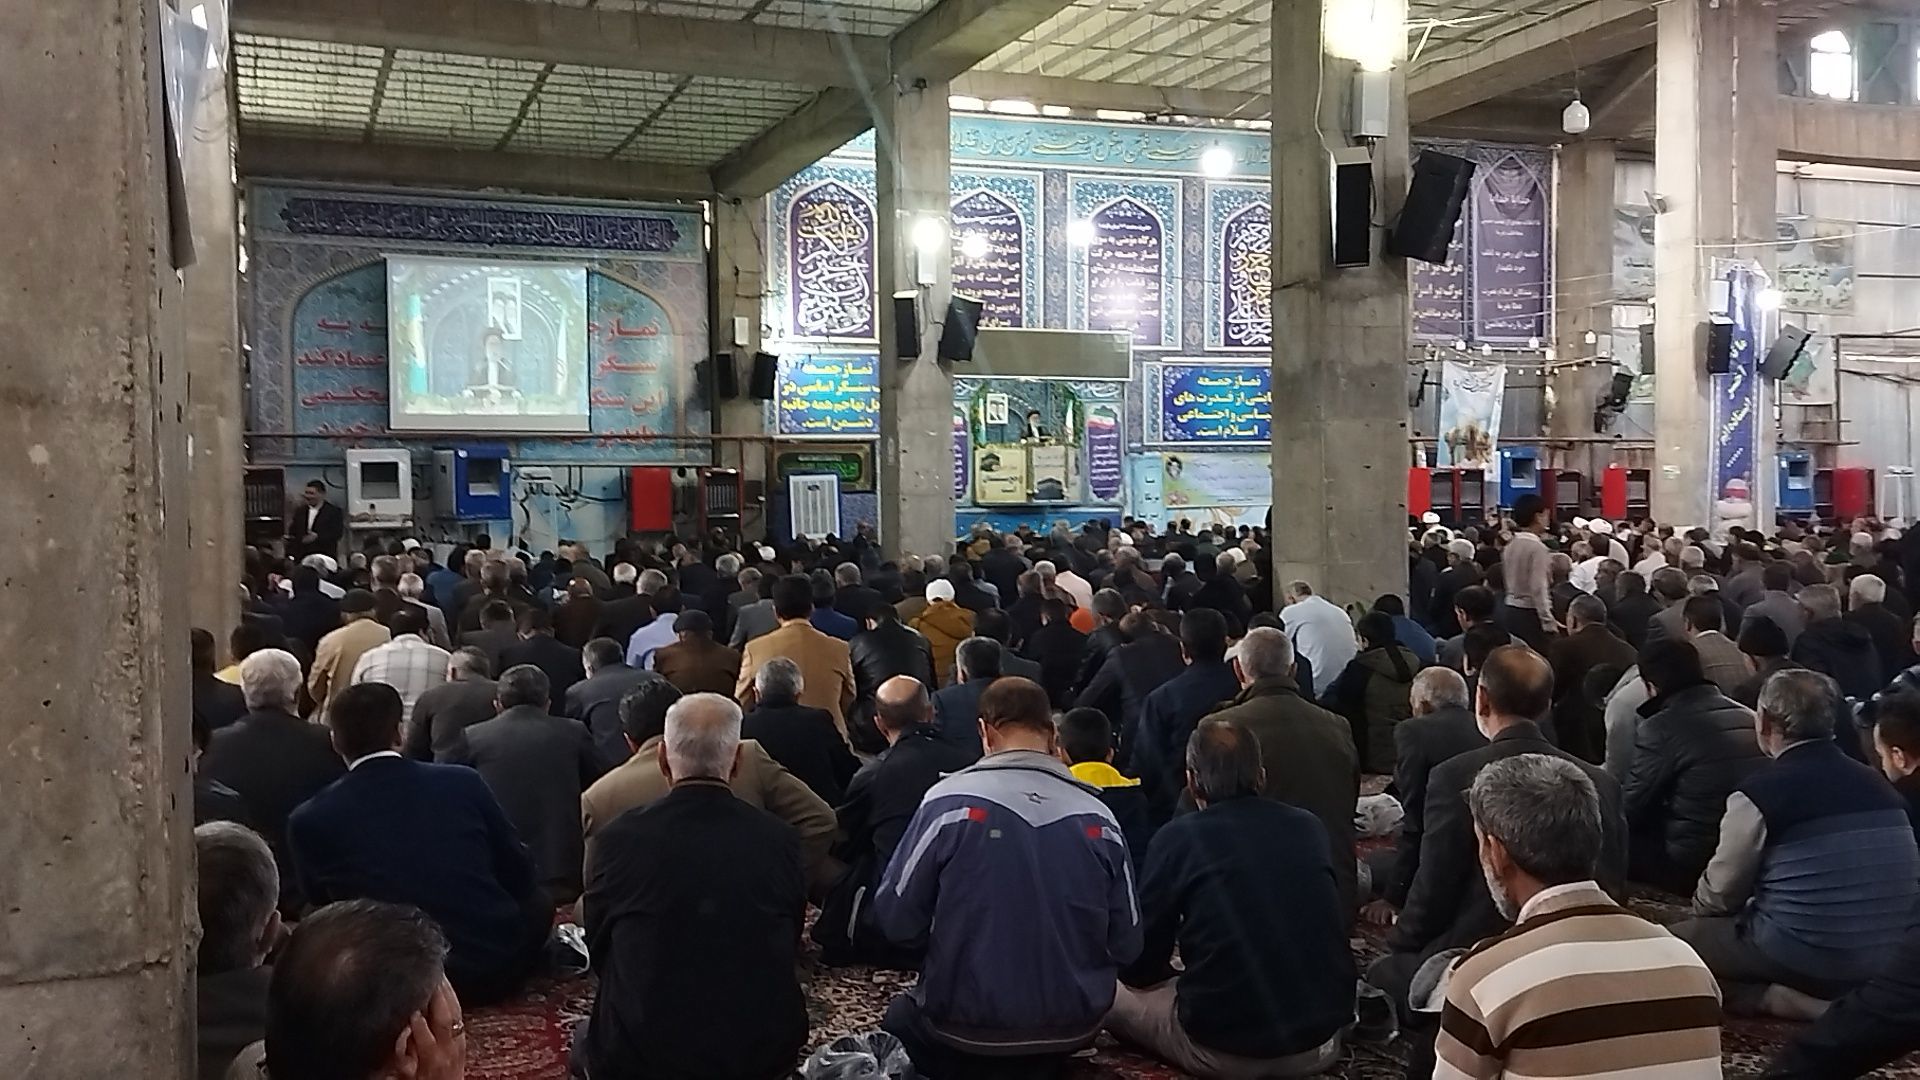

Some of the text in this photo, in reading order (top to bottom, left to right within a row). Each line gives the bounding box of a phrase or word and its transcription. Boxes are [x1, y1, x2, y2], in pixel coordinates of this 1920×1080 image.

[606, 317, 660, 342] نماز
[597, 355, 658, 378] سنگر
[801, 361, 873, 378] نماز جمعه
[781, 380, 797, 396] در
[796, 379, 835, 397] اساسی
[836, 380, 873, 396] سنگر
[1197, 375, 1261, 389] نماز جمعه
[781, 396, 811, 412] جانبه
[811, 399, 833, 411] همه
[1173, 390, 1197, 407] های
[1197, 390, 1235, 408] قدرت
[1235, 390, 1246, 407] از
[831, 416, 873, 432] دشمن
[1176, 407, 1231, 424] اجتماعی
[1222, 423, 1259, 439] اسلام
